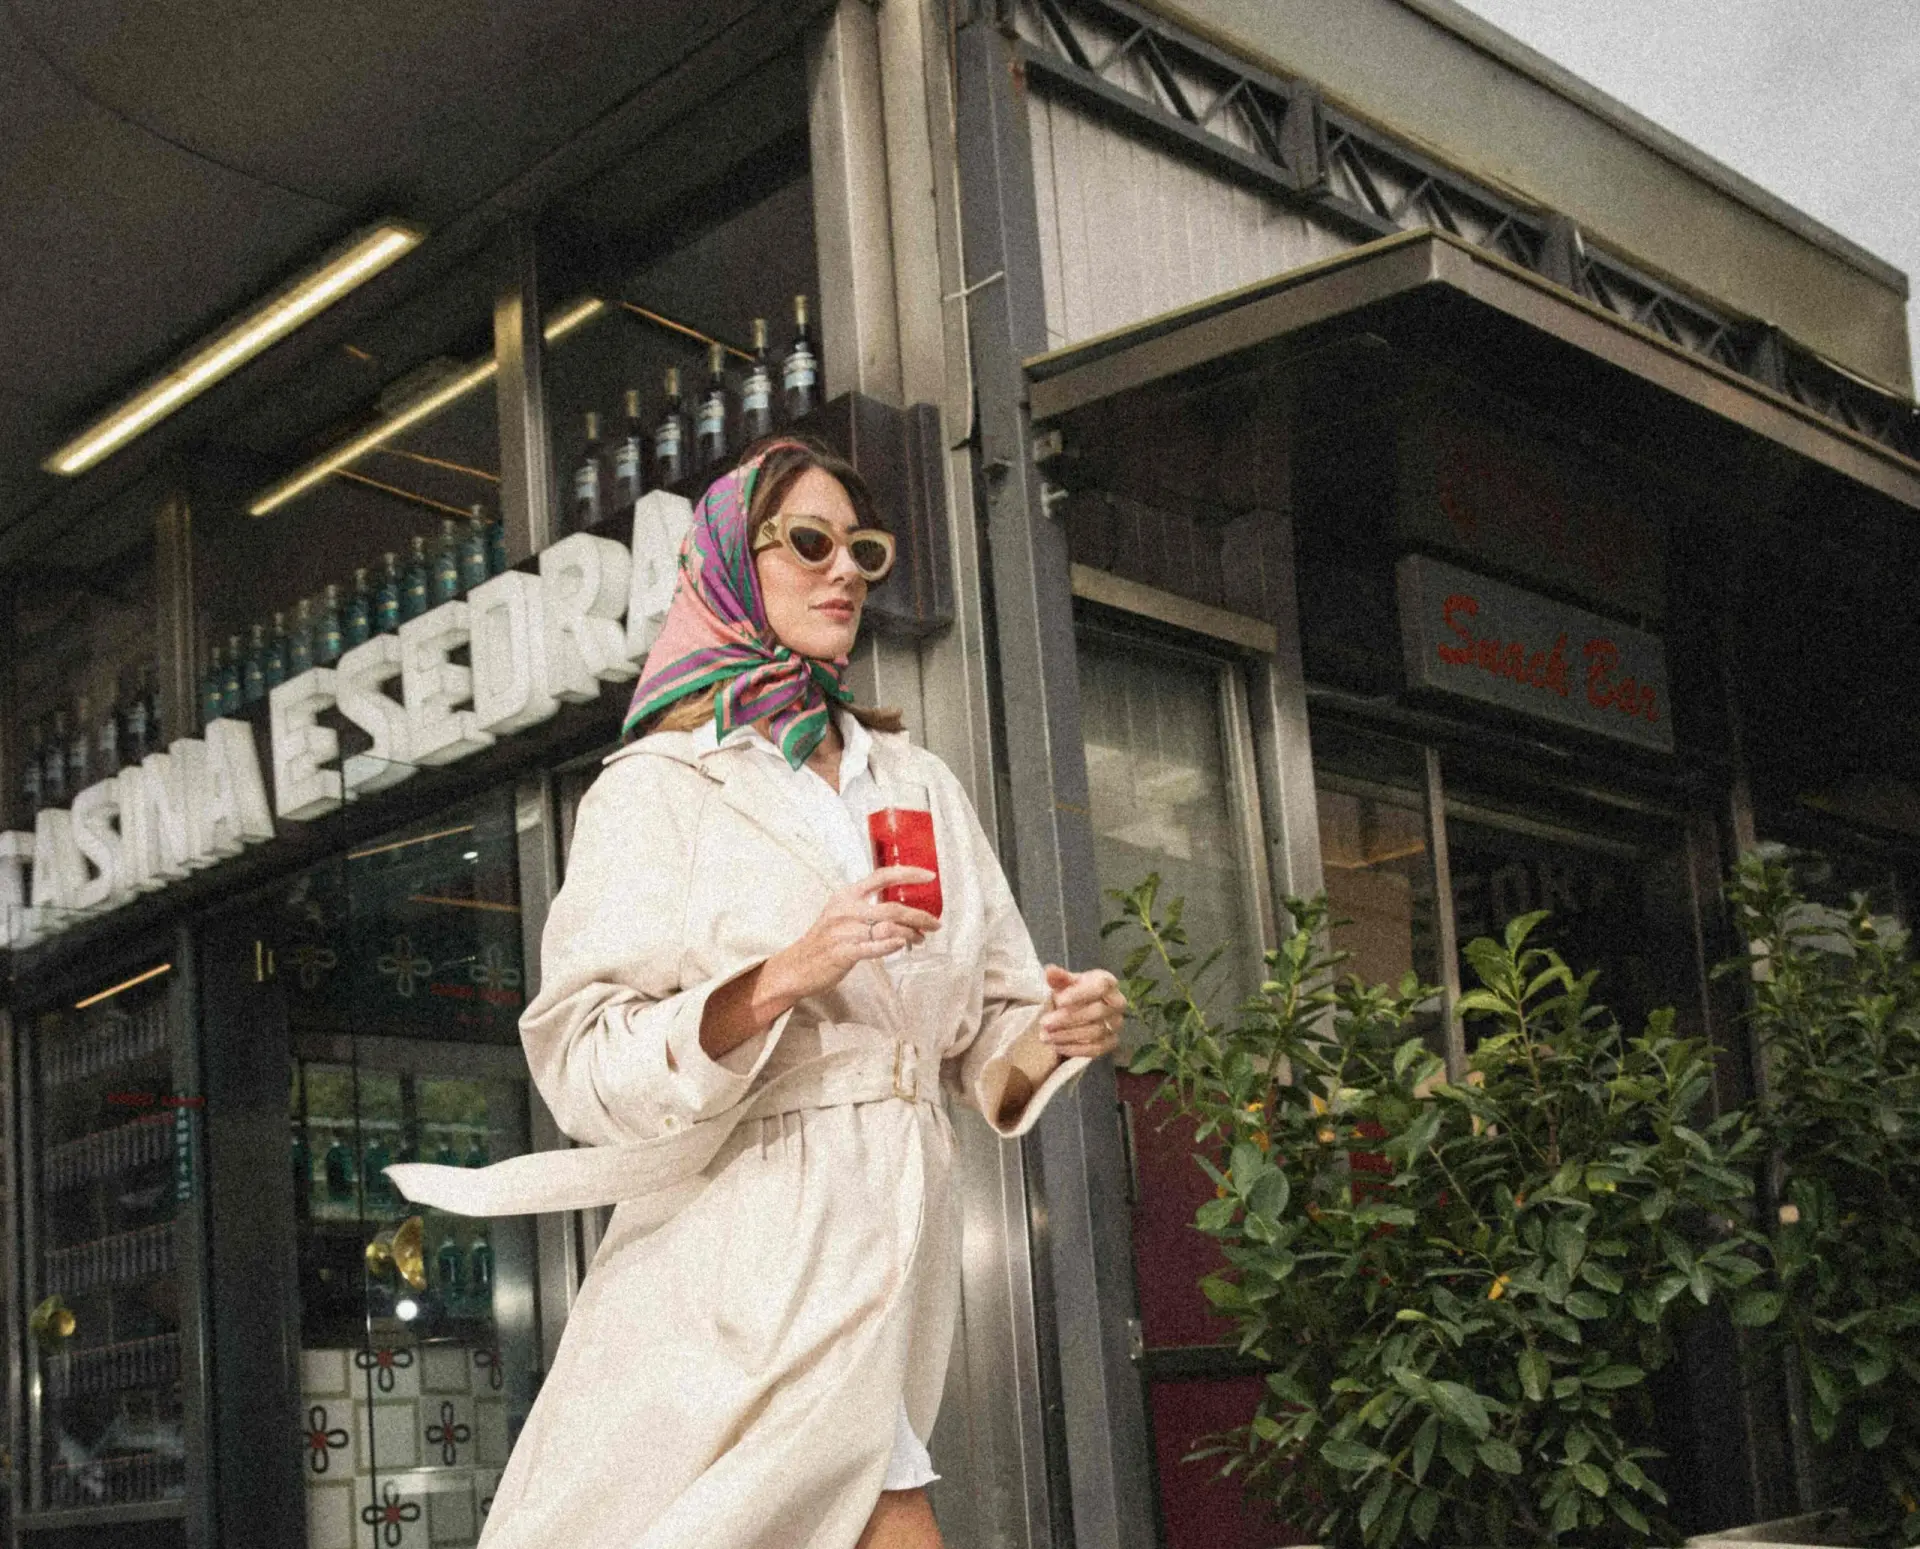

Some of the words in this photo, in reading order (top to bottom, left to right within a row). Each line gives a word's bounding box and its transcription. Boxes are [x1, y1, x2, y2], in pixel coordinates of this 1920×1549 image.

[269, 489, 692, 820] ESEDRA
[1437, 592, 1571, 697] Snack
[1582, 636, 1660, 723] Bar
